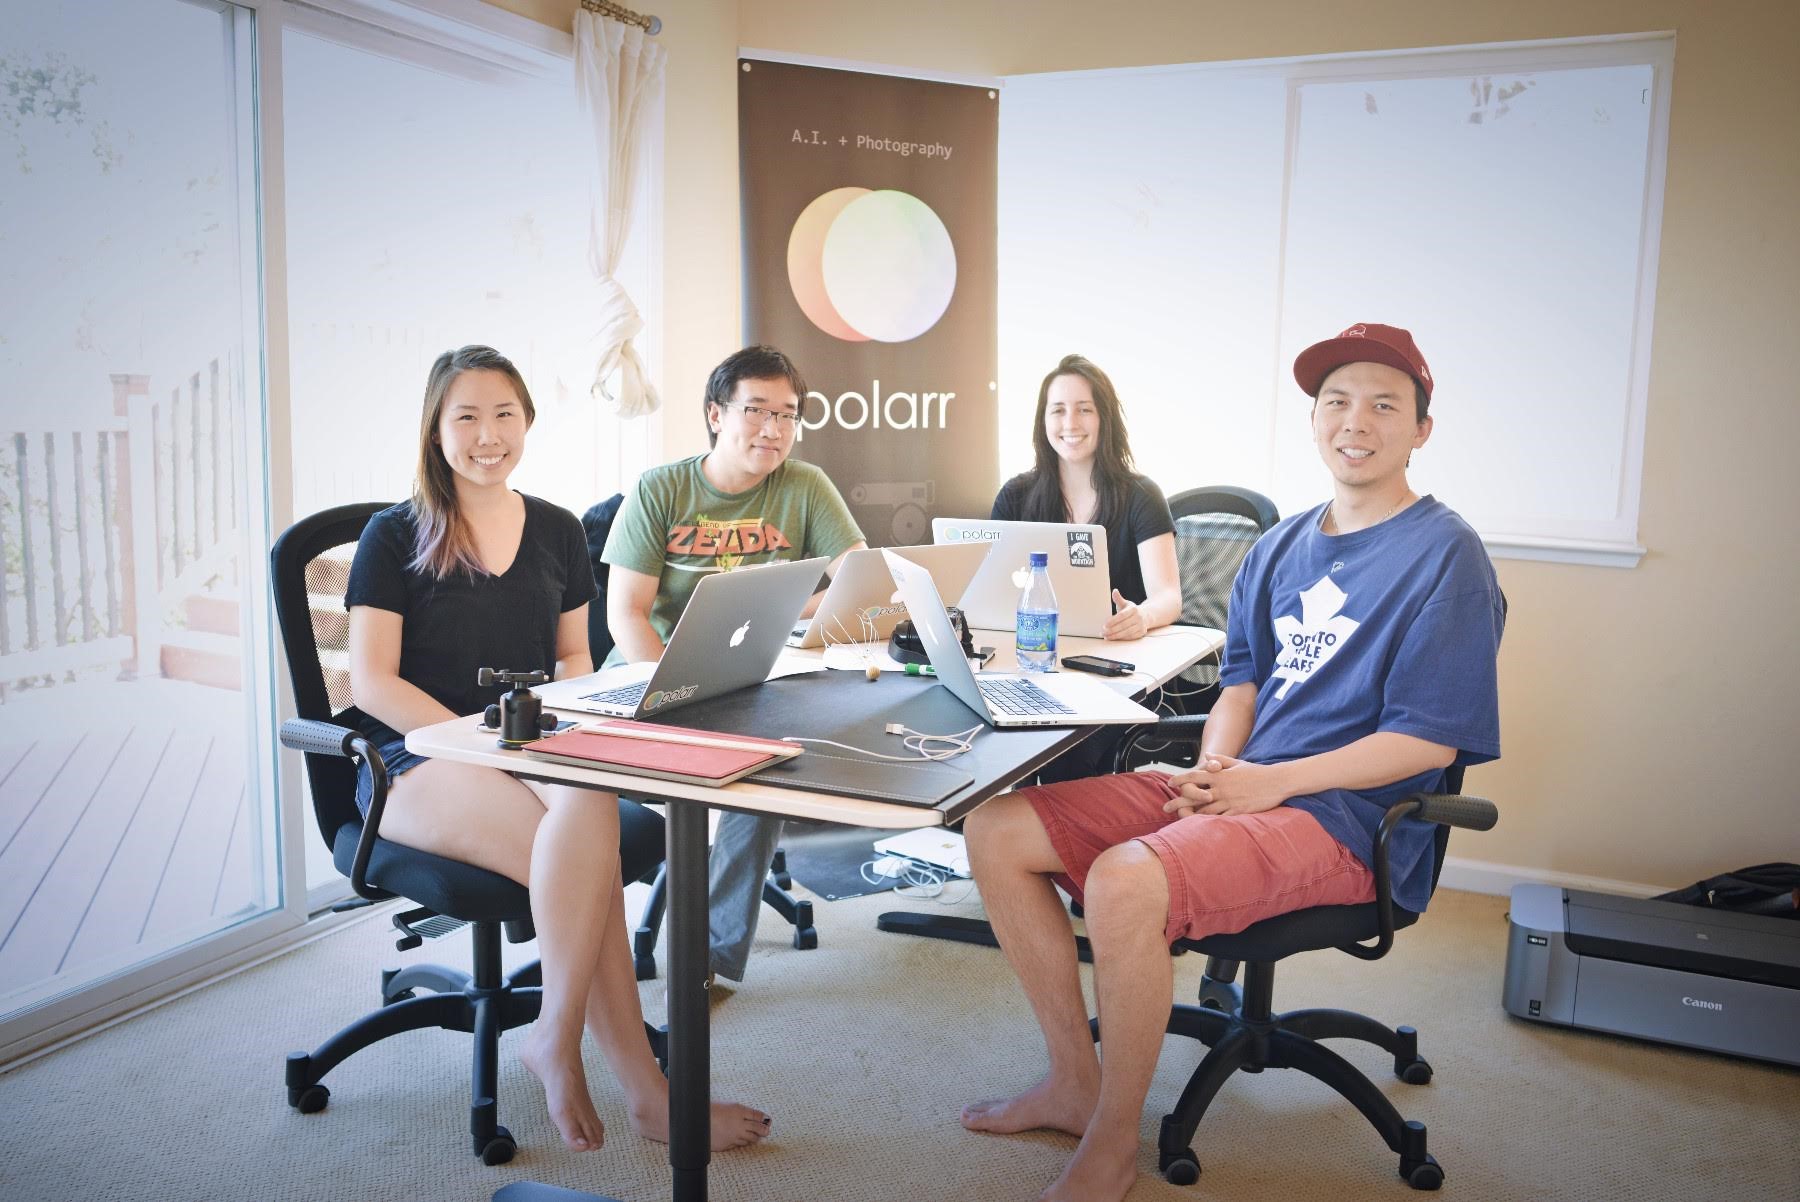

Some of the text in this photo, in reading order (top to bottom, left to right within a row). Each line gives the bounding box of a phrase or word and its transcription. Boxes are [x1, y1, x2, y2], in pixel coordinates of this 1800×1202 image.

[791, 129, 953, 161] A.I. + Photography
[796, 379, 956, 442] polarr
[666, 523, 793, 556] ZELDA
[962, 528, 1001, 541] polarr
[879, 602, 908, 616] pola
[659, 685, 699, 707] polarr
[1682, 996, 1723, 1011] Canon
